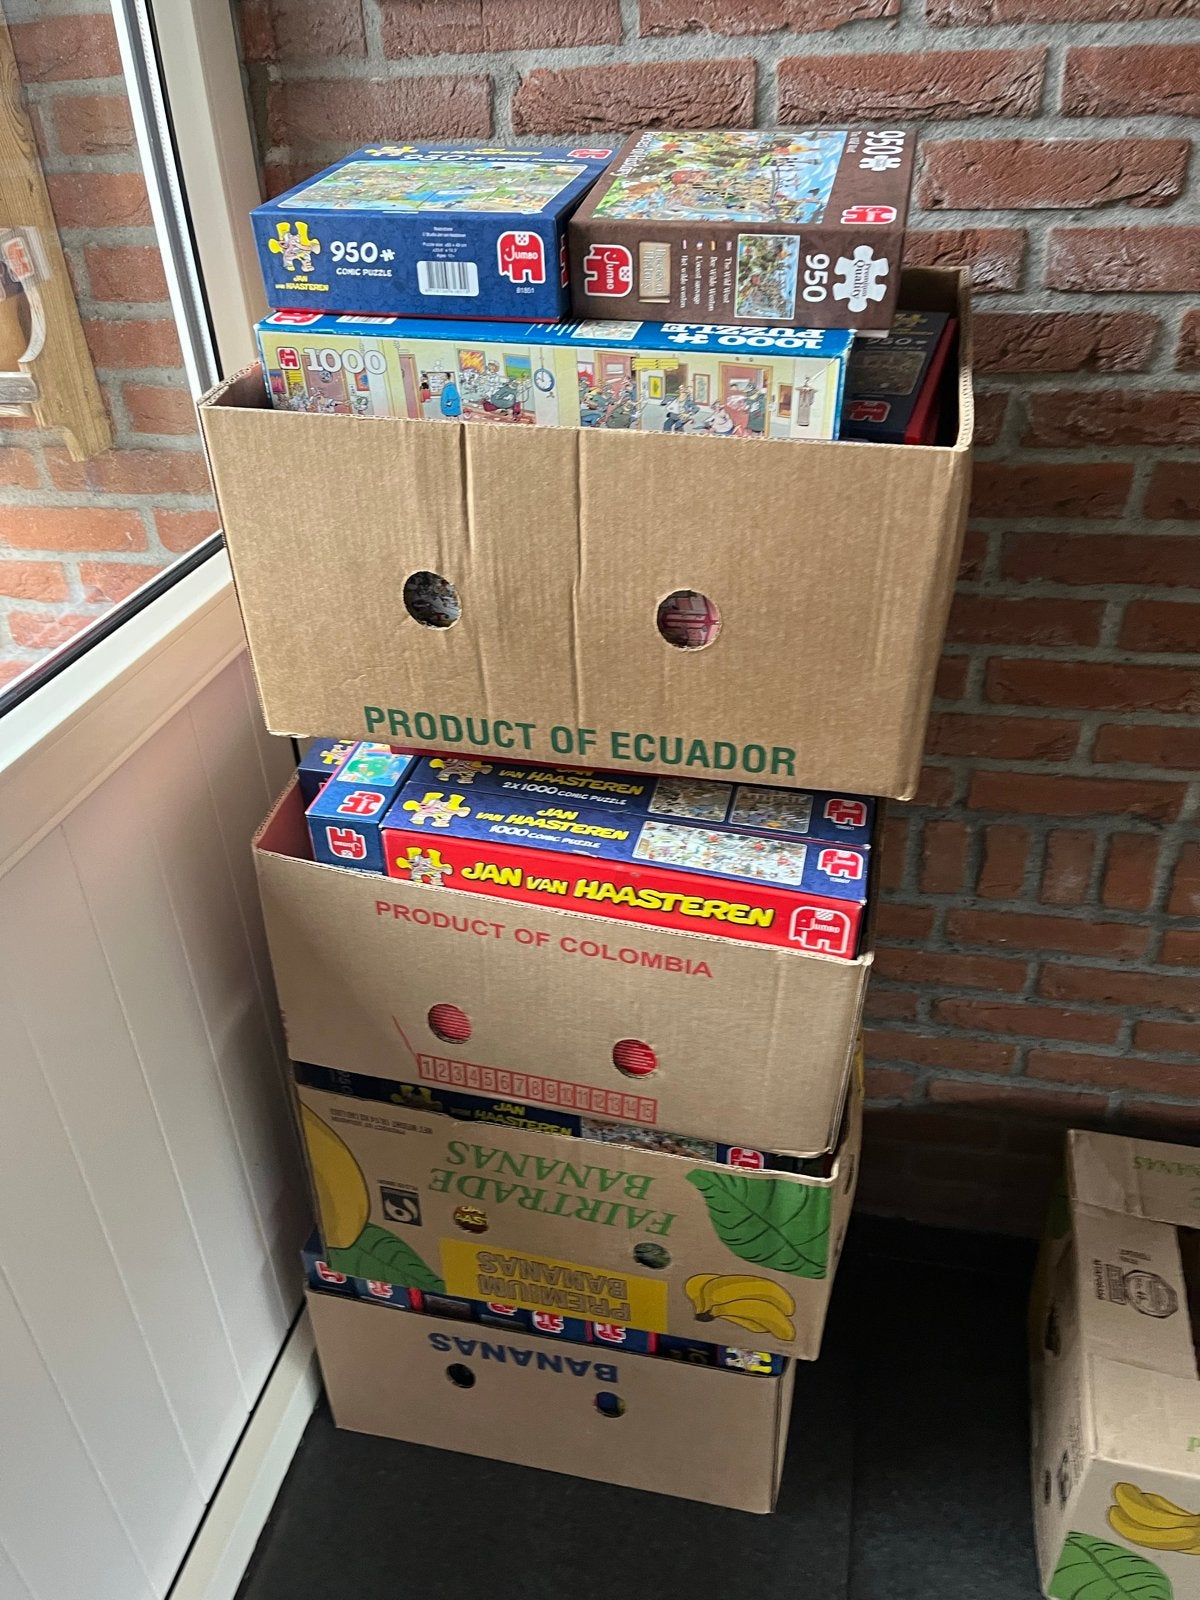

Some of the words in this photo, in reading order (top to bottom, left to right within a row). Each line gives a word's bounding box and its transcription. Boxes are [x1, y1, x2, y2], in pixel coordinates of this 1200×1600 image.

[863, 130, 906, 155] 950
[330, 241, 378, 263] 950
[336, 267, 361, 277] COMIC
[362, 269, 392, 278] PUZZLE
[802, 253, 831, 302] 950
[850, 259, 866, 299] Quality
[660, 323, 826, 340] PUZZLE
[718, 334, 823, 350] 1000
[303, 347, 387, 376] 1000
[364, 706, 534, 752] PRODUCT
[550, 725, 597, 756] OF
[611, 732, 797, 777] ECUADOR
[498, 770, 527, 780] VAN
[527, 771, 644, 796] HAASTEREN
[522, 782, 558, 795] 1000
[558, 790, 589, 801] COMIC
[591, 795, 627, 806] PUZZLE
[475, 812, 505, 822] VAN
[505, 814, 630, 841] HAASTEREN
[536, 807, 580, 821] JAN
[488, 824, 530, 837] 1000
[530, 832, 561, 842] COMIC
[562, 837, 602, 849] PUZZLE
[461, 861, 523, 887] JAN
[526, 876, 568, 895] VAN
[574, 879, 775, 929] HAASTEREN
[375, 901, 506, 940] PRODUCT
[513, 928, 551, 946] OF
[559, 936, 713, 979] COLOMBIA
[422, 1061, 431, 1073] 1
[438, 1063, 447, 1078] 2
[453, 1066, 463, 1081] 3
[467, 1068, 479, 1084] 4
[484, 1071, 494, 1087] 5
[499, 1074, 510, 1090] 6
[515, 1077, 526, 1092] 7
[530, 1080, 541, 1096] 8
[546, 1084, 557, 1099] 9
[560, 1086, 573, 1102] 10
[577, 1089, 589, 1105] 11
[592, 1092, 606, 1108] 12
[608, 1095, 622, 1112] 13
[625, 1098, 637, 1115] 14
[640, 1102, 653, 1119] 15
[474, 1109, 573, 1137] HAASTEREN
[493, 1103, 526, 1116] JAN
[447, 1139, 656, 1200] BANANAS
[429, 1167, 678, 1237] FAIRTRADE
[476, 1251, 628, 1298] BANANAS
[478, 1273, 631, 1321] PREMIUM
[428, 1332, 618, 1383] BANANAS
